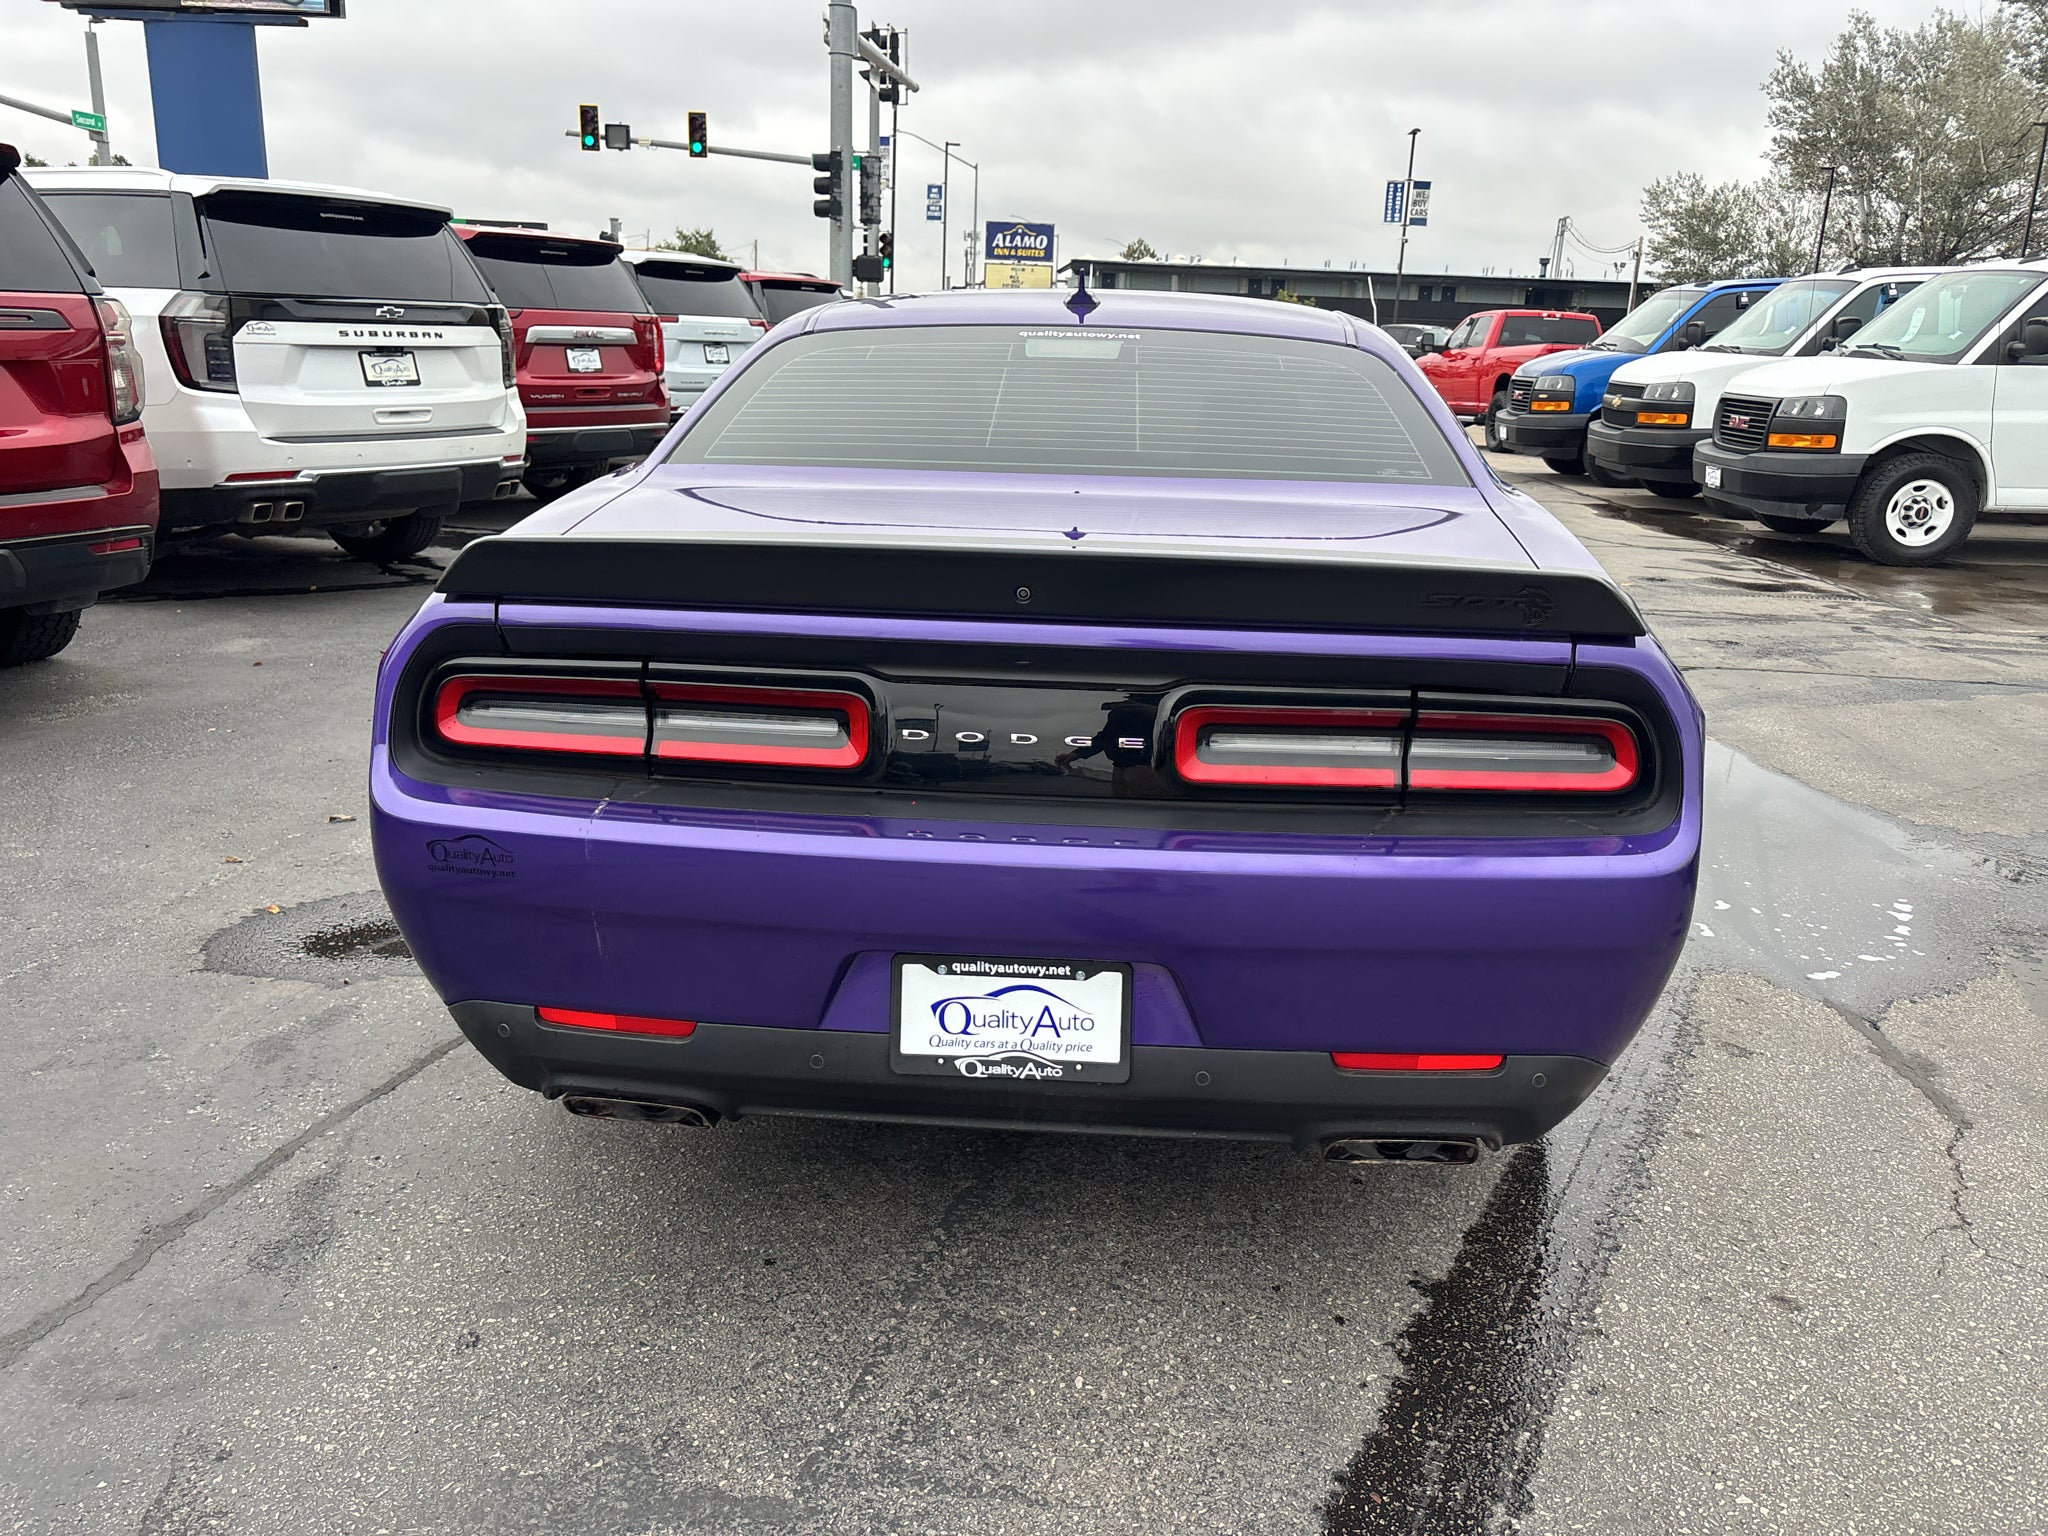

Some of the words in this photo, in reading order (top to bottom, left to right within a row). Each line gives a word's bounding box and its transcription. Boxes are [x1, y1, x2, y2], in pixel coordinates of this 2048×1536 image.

[1415, 190, 1427, 199] WE
[1412, 199, 1427, 208] BUY
[1410, 208, 1428, 217] CARS
[992, 233, 1048, 249] ALAMO
[993, 248, 1010, 256] INN
[1010, 248, 1016, 256] &
[1017, 249, 1046, 257] SUITES
[338, 330, 444, 339] SUBURBAN
[1018, 330, 1142, 340] qualityautowy.net
[902, 729, 1145, 748] DODGE
[428, 864, 517, 878] qualityautowy.net
[952, 961, 1071, 977] qualityautowy.net
[929, 1034, 972, 1050] Quality
[973, 1040, 996, 1049] cars
[997, 1040, 1010, 1050] at
[1019, 1038, 1063, 1054] Quality
[1064, 1042, 1093, 1053] price
